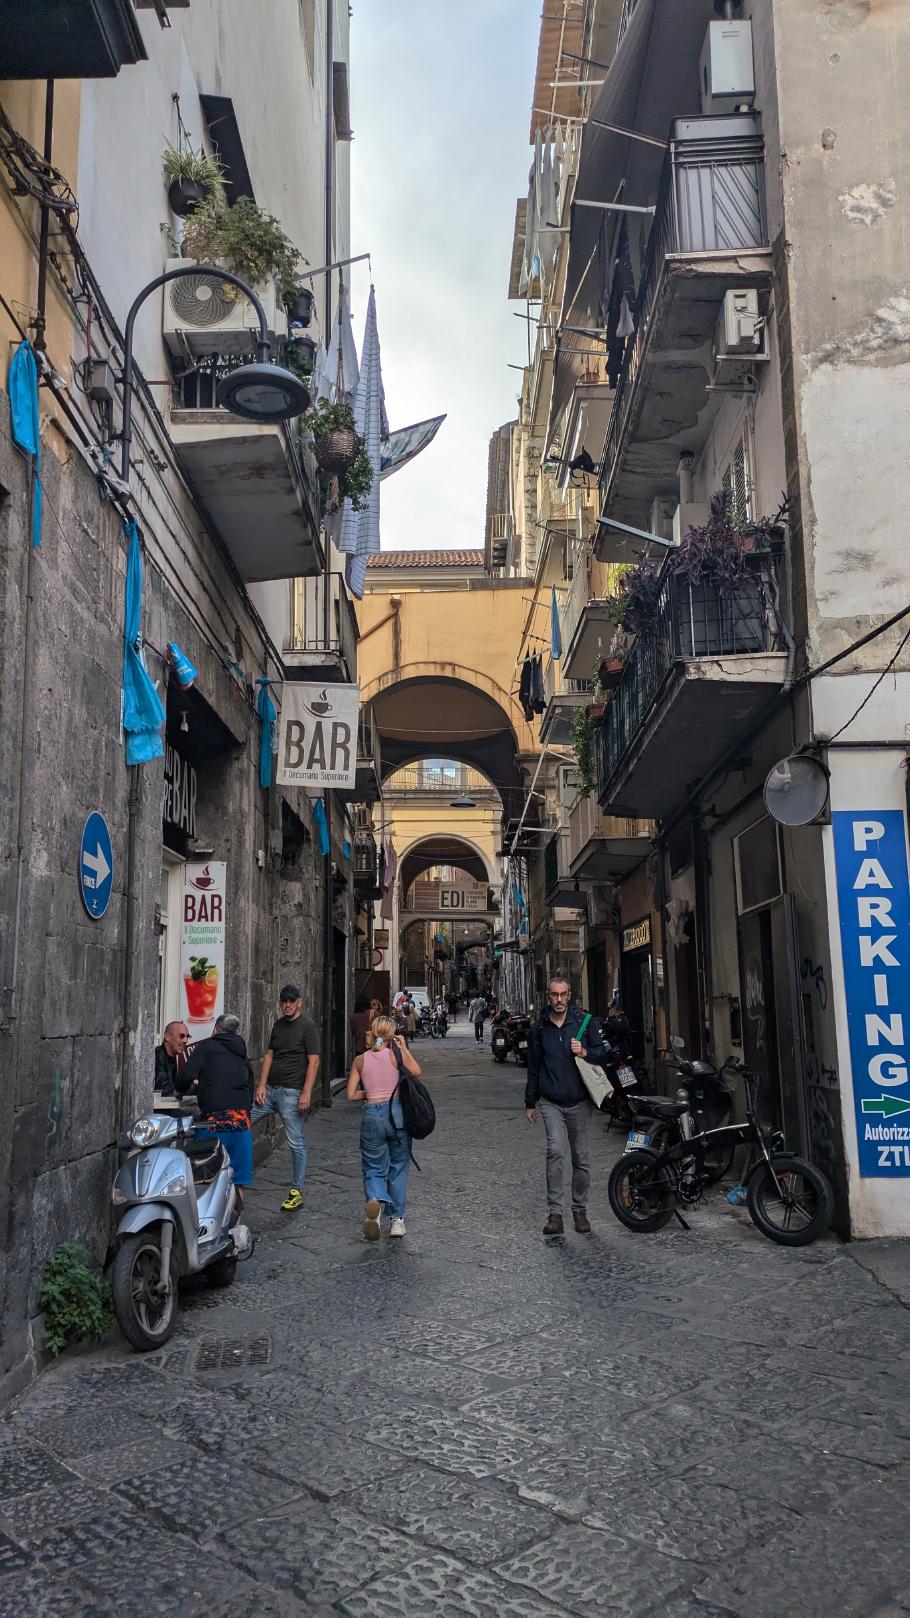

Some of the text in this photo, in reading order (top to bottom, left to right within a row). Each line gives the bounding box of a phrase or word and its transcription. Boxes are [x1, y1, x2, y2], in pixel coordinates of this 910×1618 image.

[283, 719, 352, 772] BAR
[288, 770, 319, 780] Decumano
[320, 771, 349, 782] Superiore
[173, 749, 197, 839] BAR
[440, 890, 465, 908] EDI
[183, 894, 223, 923] BAR
[189, 925, 222, 934] Decumano
[187, 935, 218, 945] Superiore
[852, 821, 909, 1087] PARKING
[864, 1123, 910, 1141] Autorizz
